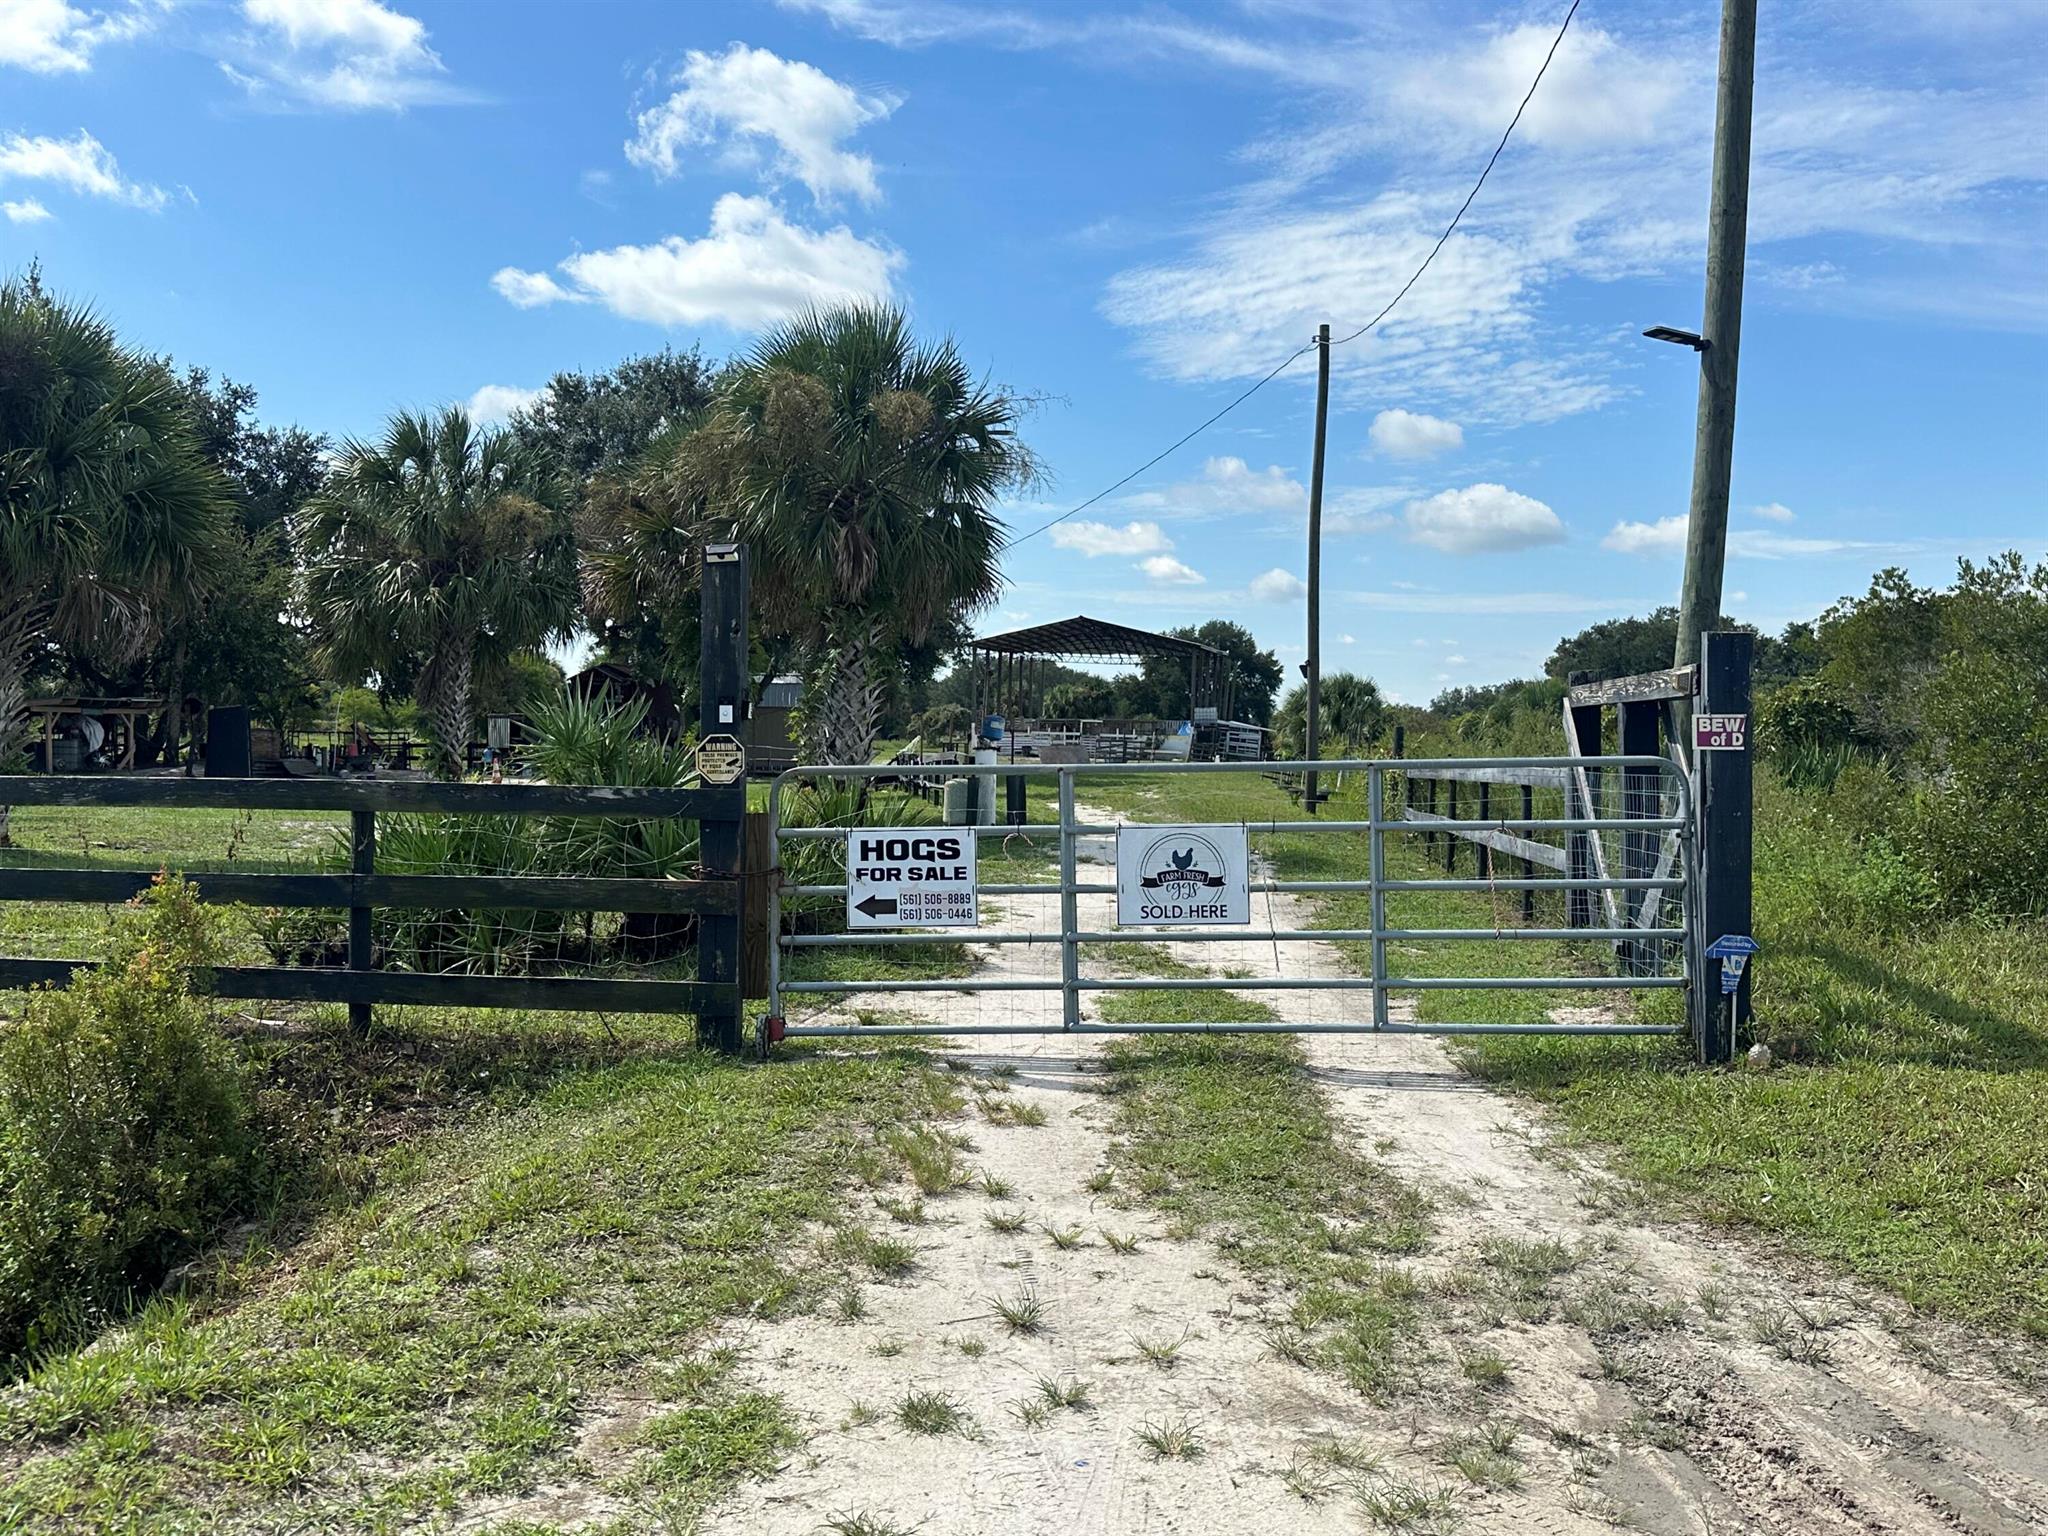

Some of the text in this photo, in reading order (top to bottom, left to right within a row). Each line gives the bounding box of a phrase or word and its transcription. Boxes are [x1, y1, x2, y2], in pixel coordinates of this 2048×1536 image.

[1698, 718, 1744, 732] BEW
[1710, 732, 1727, 746] of
[705, 742, 737, 751] WARNING
[860, 838, 961, 863] HOGS
[855, 866, 968, 882] FOR SALE
[1160, 871, 1206, 882] FARM FRESH
[1166, 882, 1200, 900] eggs
[900, 893, 971, 906] (561) 506-8889
[900, 908, 973, 920] (561) 506-0446
[1140, 904, 1228, 919] SOLD HERE
